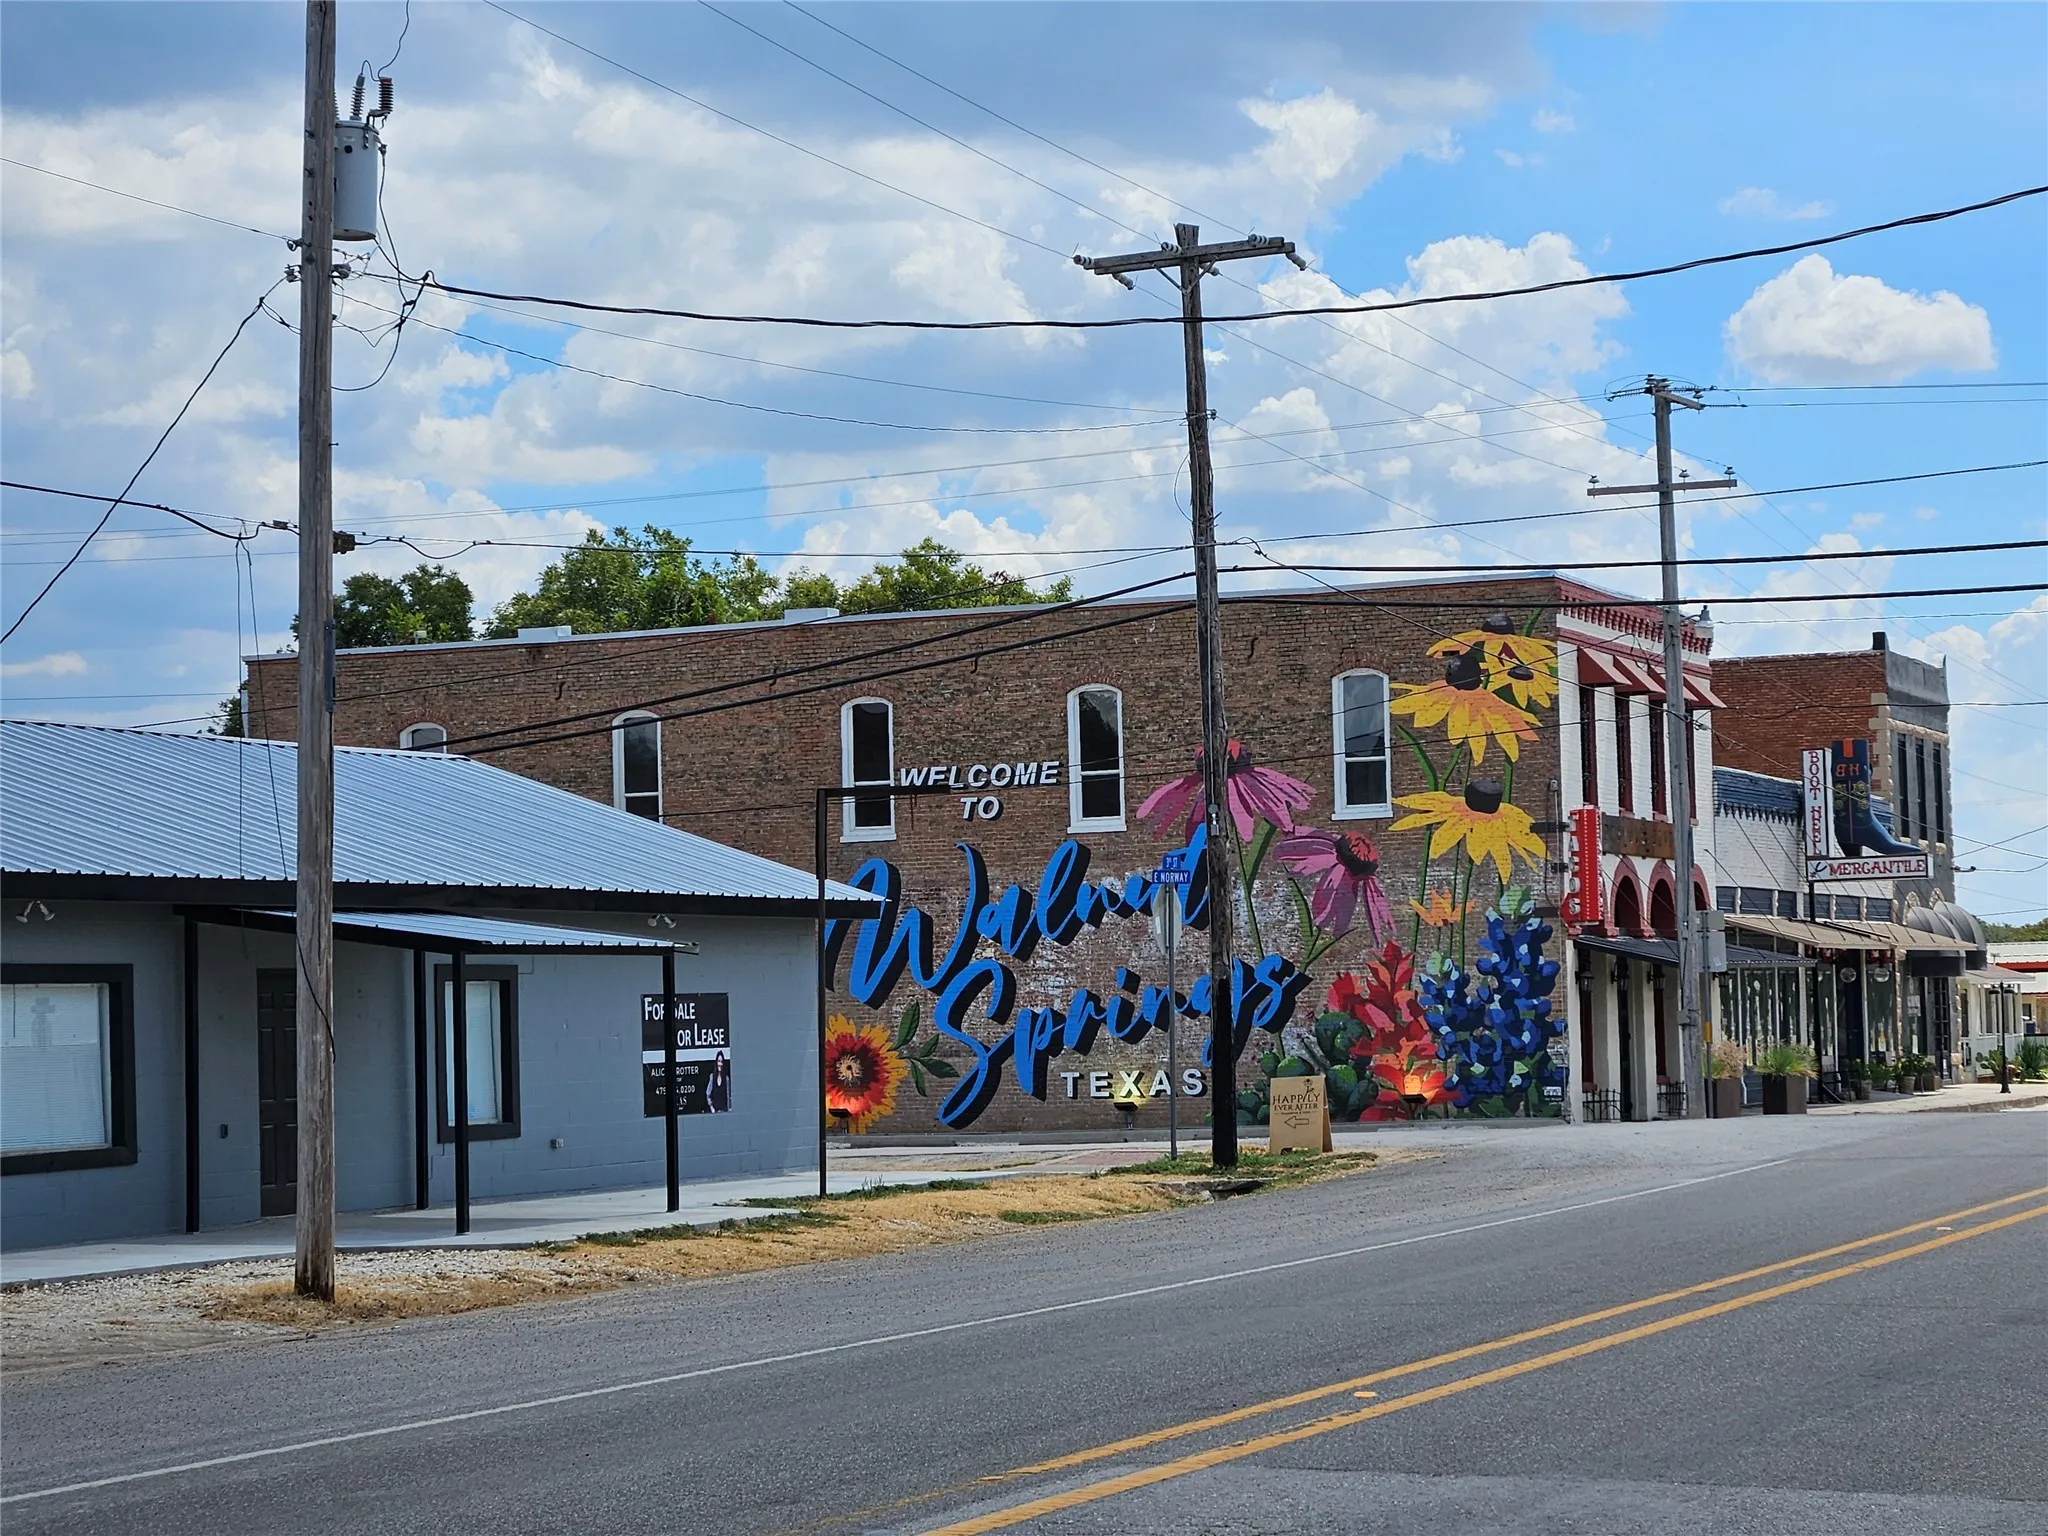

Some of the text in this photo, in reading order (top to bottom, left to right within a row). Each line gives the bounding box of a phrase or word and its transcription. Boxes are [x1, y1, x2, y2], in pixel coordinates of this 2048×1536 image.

[899, 760, 1062, 790] WELCOME
[1808, 751, 1821, 801] BOOT
[960, 796, 1001, 820] TO
[1154, 872, 1189, 883] E NORWAY
[1829, 860, 1926, 876] MERCANTILE
[826, 822, 1213, 1007] Walnut
[937, 953, 1302, 1128] Springs
[675, 1065, 700, 1075] ROTTER
[1060, 1068, 1207, 1097] TEXAS
[1272, 1091, 1320, 1105] HAPPILY
[1294, 1103, 1318, 1111] AFTER
